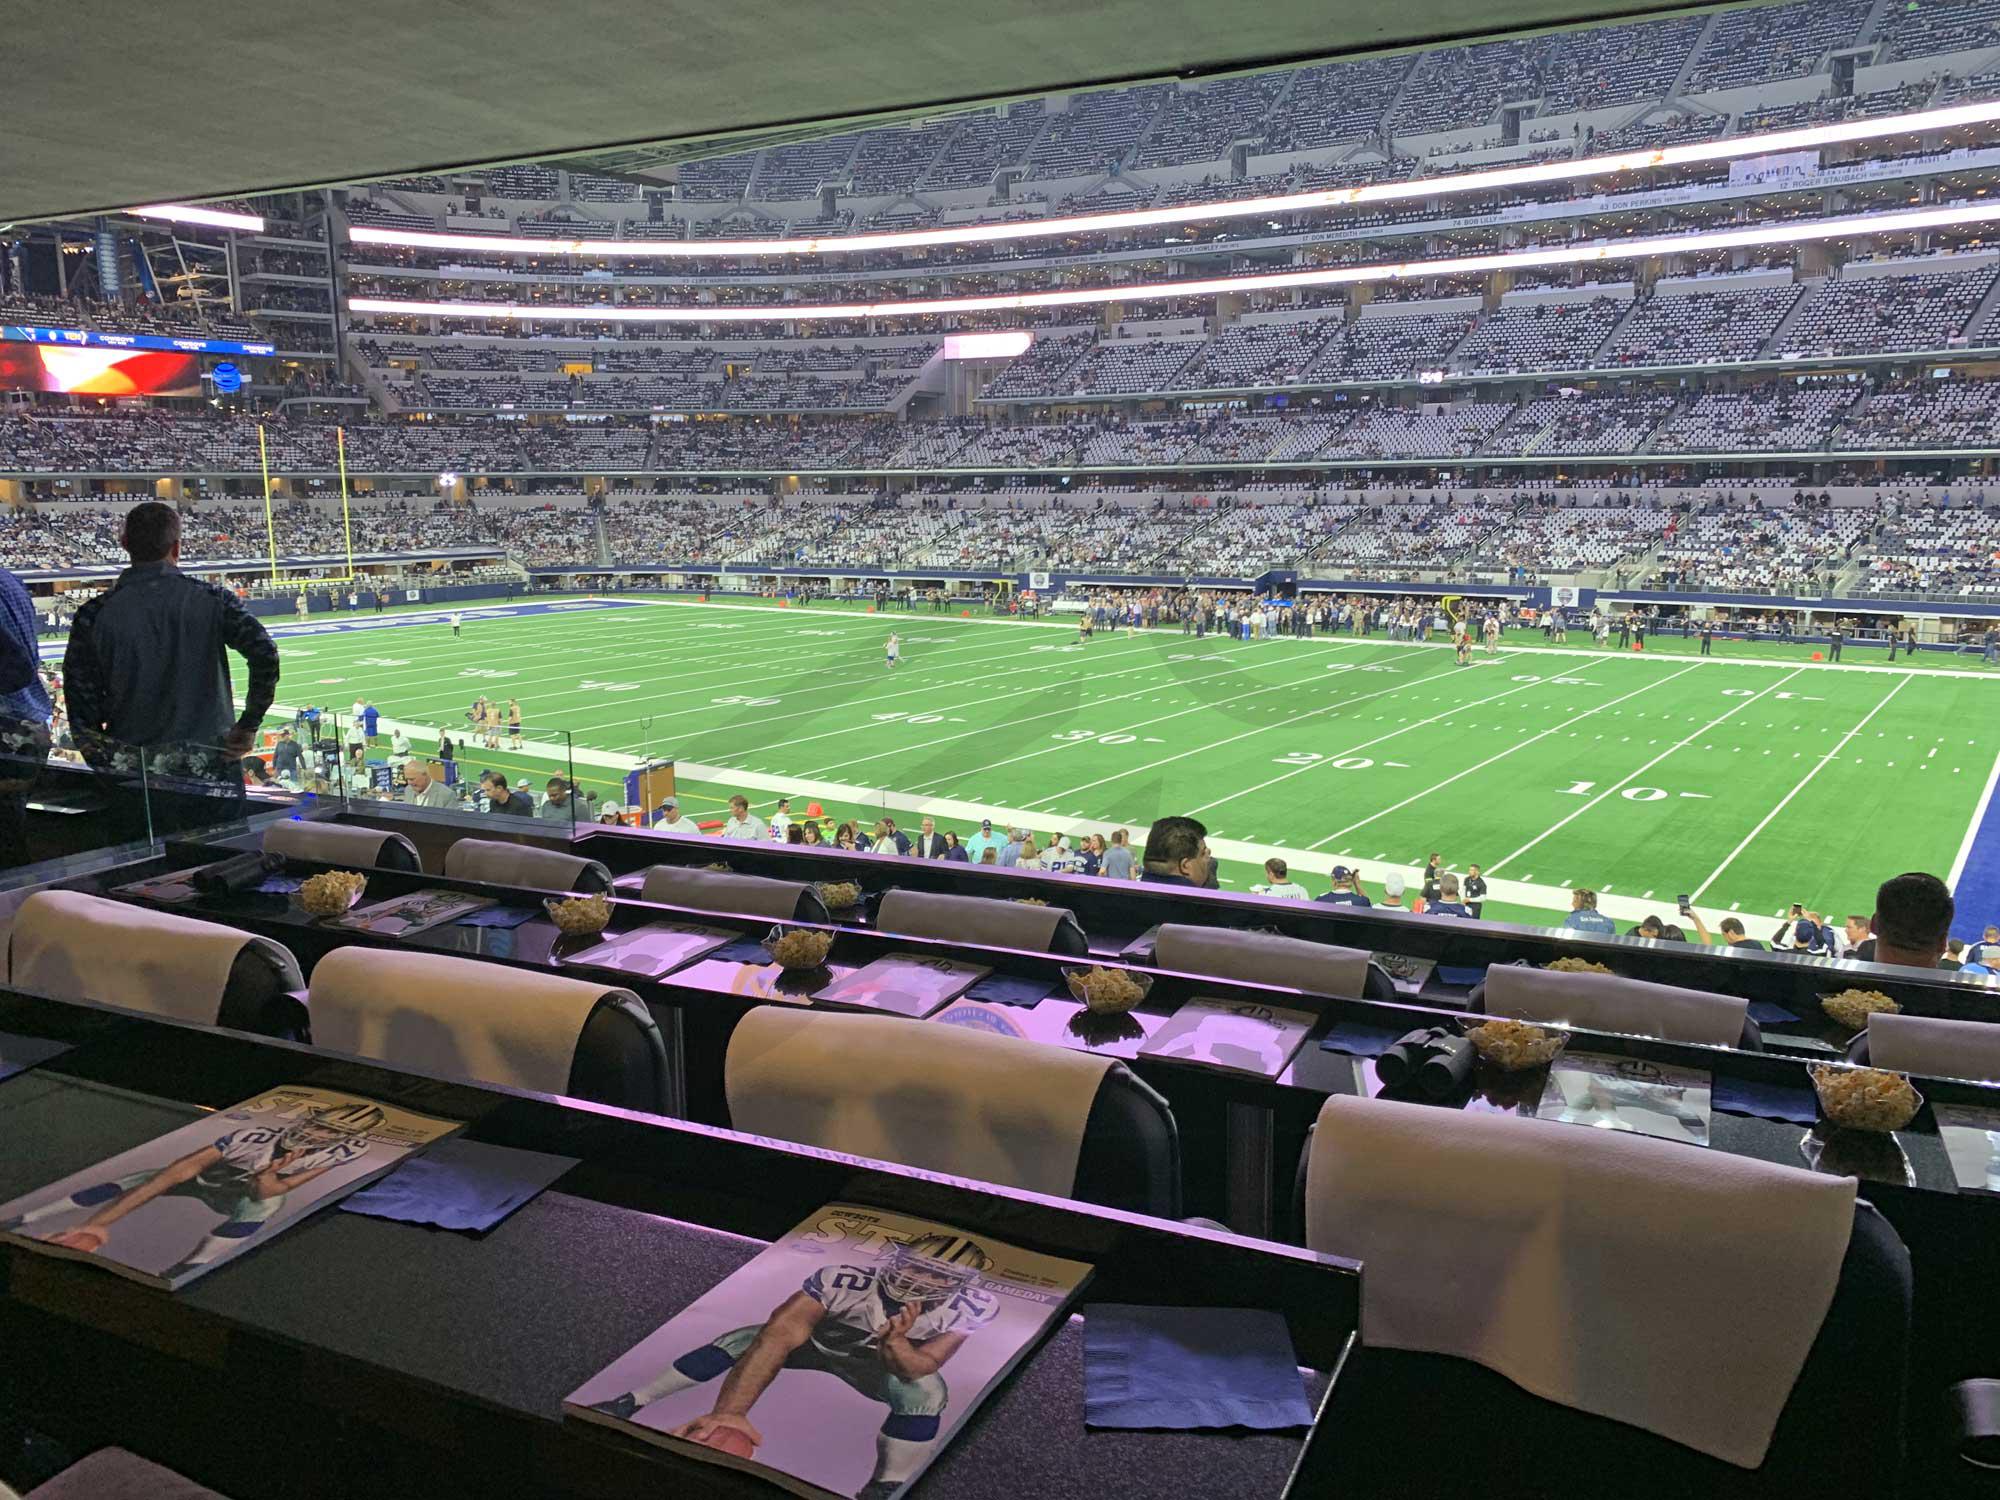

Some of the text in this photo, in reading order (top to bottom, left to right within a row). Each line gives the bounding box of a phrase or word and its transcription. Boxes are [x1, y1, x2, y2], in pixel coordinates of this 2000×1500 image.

[1793, 176, 1821, 189] ROGER
[1823, 172, 1868, 185] STAUBACH
[1612, 201, 1628, 210] DON
[1630, 197, 1663, 209] PERKINS
[1464, 217, 1479, 226] BOB
[1480, 215, 1498, 225] LILLY
[1311, 233, 1325, 241] DON
[1326, 230, 1358, 240] MEREDITH
[871, 712, 944, 724] 40
[1051, 730, 1137, 745] 30
[1272, 752, 1375, 770] 20
[1555, 781, 1669, 802] 10
[984, 1280, 1052, 1303] GAMEDAY
